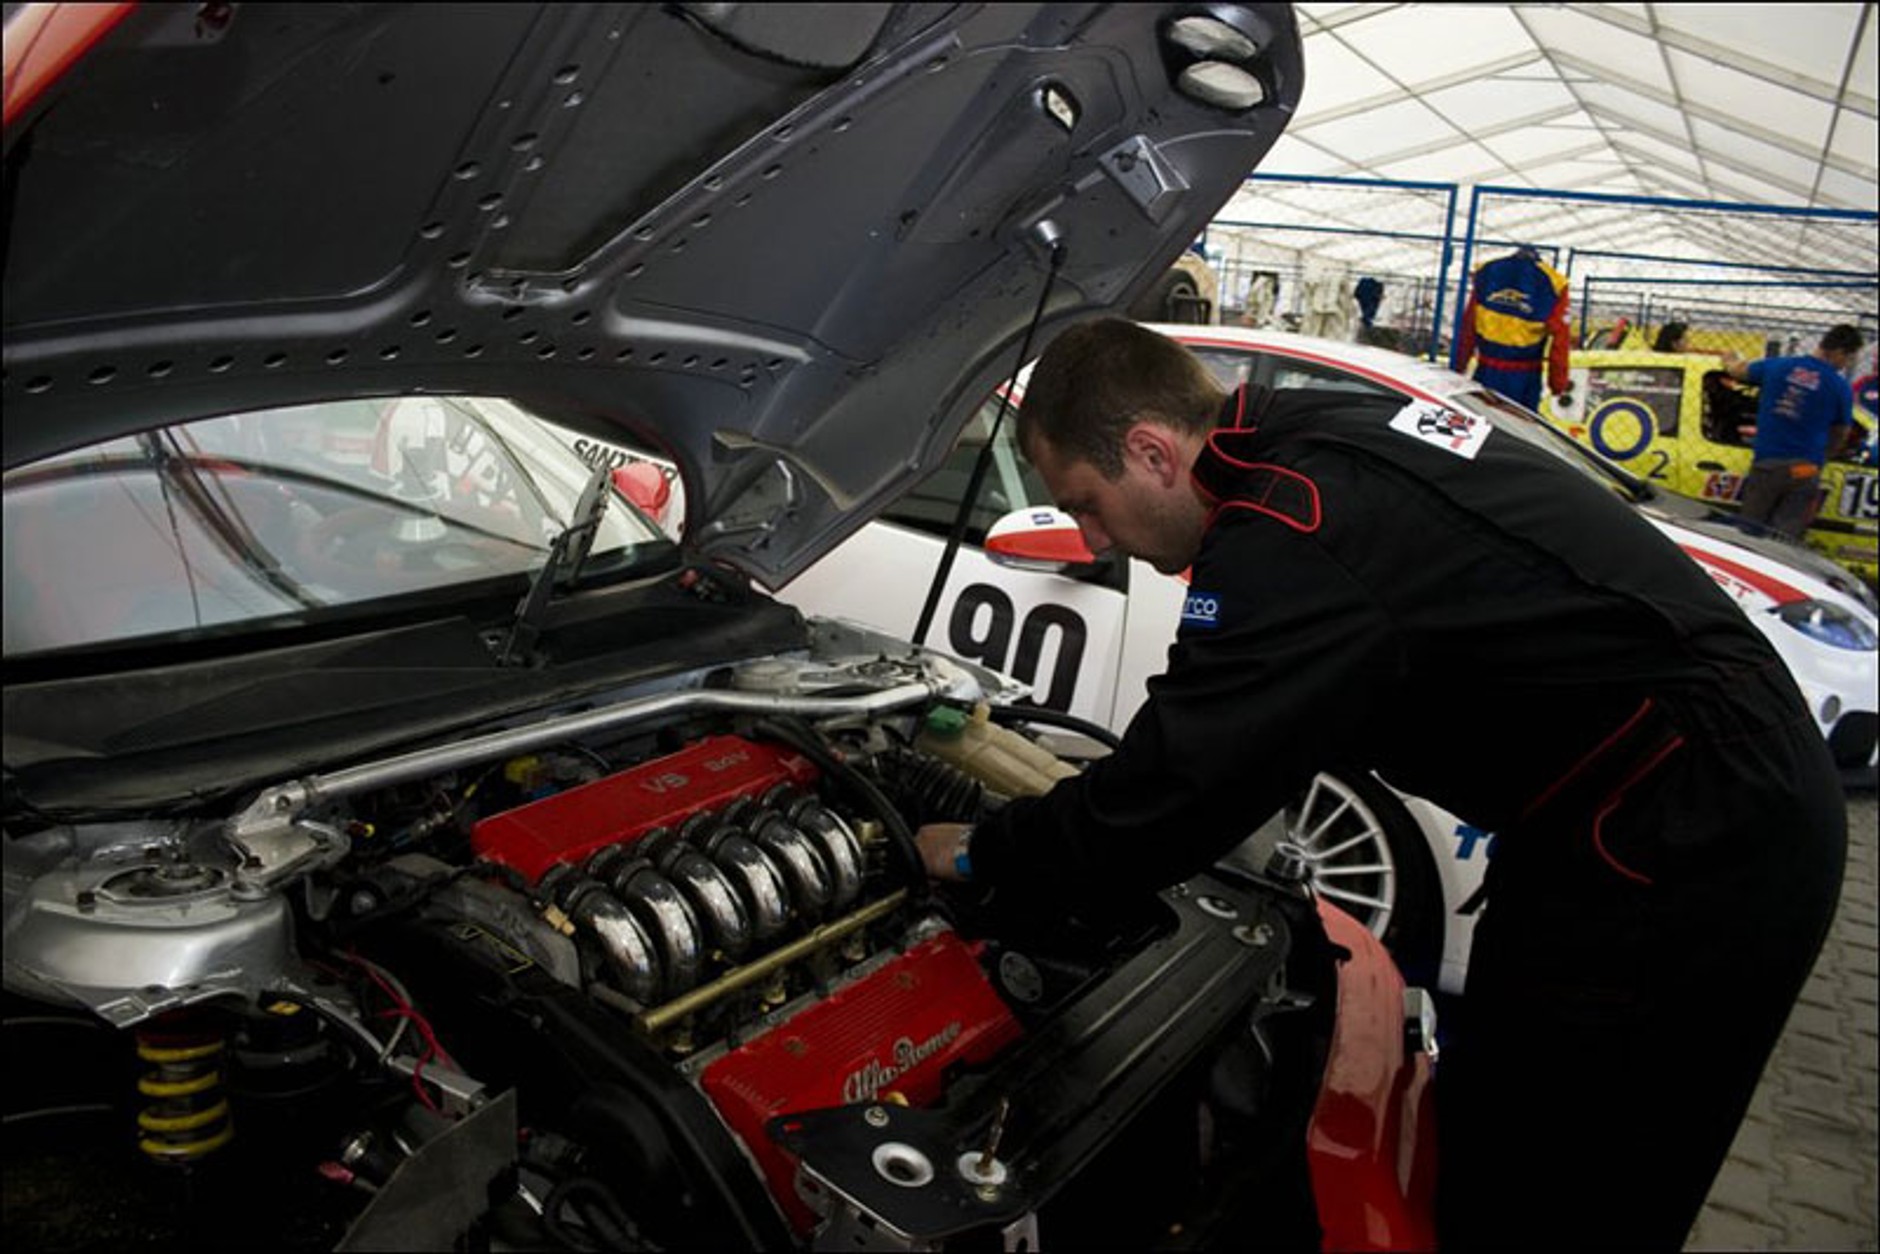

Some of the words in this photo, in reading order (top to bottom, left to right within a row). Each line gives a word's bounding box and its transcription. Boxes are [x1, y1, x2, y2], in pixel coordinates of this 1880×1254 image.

[948, 582, 1088, 715] 90
[843, 1056, 899, 1104] Alfa
[892, 1020, 961, 1073] Romeo
